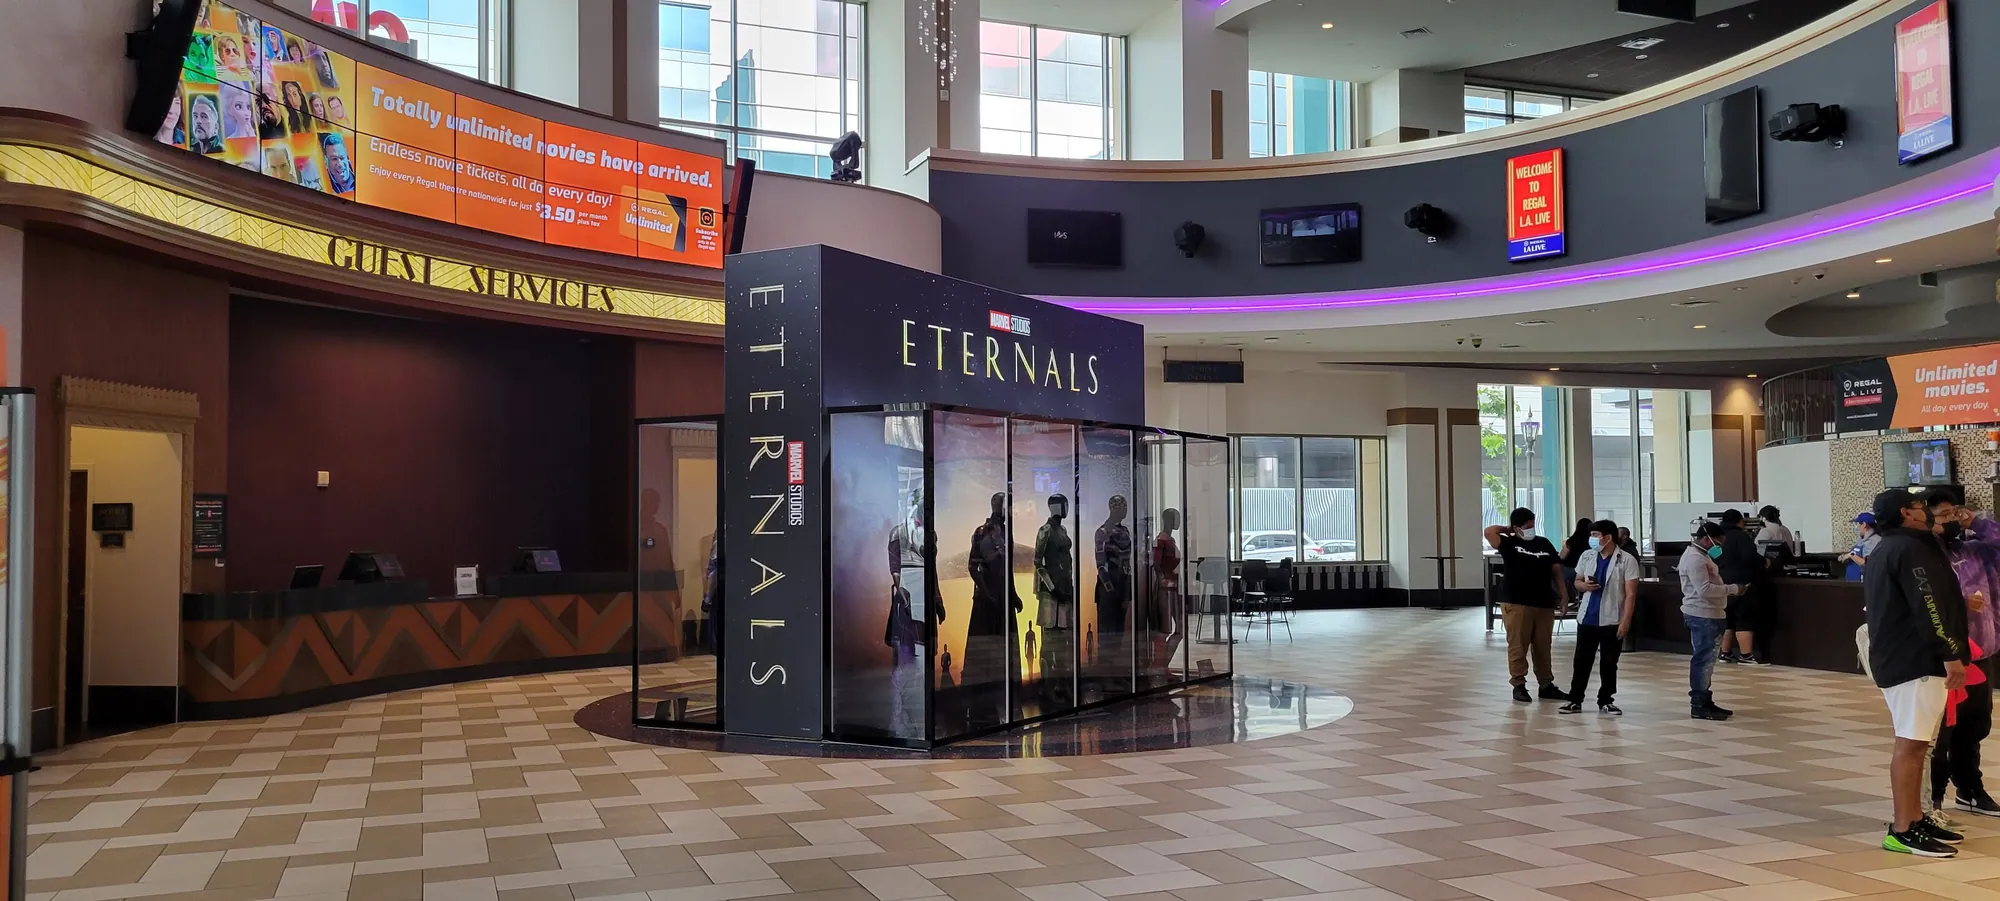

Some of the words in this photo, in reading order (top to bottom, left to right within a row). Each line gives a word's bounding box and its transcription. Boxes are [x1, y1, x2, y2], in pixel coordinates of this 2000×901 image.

[372, 86, 441, 128] Totally
[446, 114, 533, 151] unlimited
[601, 150, 643, 175] have
[648, 165, 713, 188] arrived.
[370, 137, 422, 162] Endless
[425, 153, 463, 173] movie
[467, 163, 509, 186] tickets,
[512, 175, 527, 190] all
[549, 186, 584, 203] every
[587, 191, 612, 208] day!
[1516, 161, 1552, 180] WELCOME
[369, 164, 391, 179] Enjoy
[393, 172, 414, 184] every
[416, 175, 437, 189] Regal
[439, 183, 467, 196] theatre
[468, 190, 507, 205] nationwide
[508, 198, 518, 207] for
[519, 201, 532, 211] just
[589, 213, 608, 221] month
[1529, 180, 1540, 193] TO
[641, 206, 668, 217] REGAL
[1523, 195, 1547, 211] REGAL
[625, 213, 672, 234] Unlimited
[1519, 214, 1533, 227] L.A.
[1535, 211, 1551, 225] LIVE
[328, 235, 432, 285] GUEST
[467, 265, 617, 314] SERVICES
[990, 311, 1010, 331] MARVEL
[1010, 316, 1030, 335] STUDIOS
[903, 319, 1098, 395] ETERNALS
[1915, 359, 1997, 383] Unlimited
[1854, 378, 1882, 388] REGAL
[1860, 387, 1882, 396] LIVE
[1925, 380, 1990, 398] movies.
[1921, 404, 1931, 414] All
[1949, 402, 1971, 414] every
[1973, 400, 1989, 411] day.
[789, 442, 803, 483] MARVEL
[750, 284, 786, 686] ETERNALS
[790, 484, 803, 527] STUDIOS
